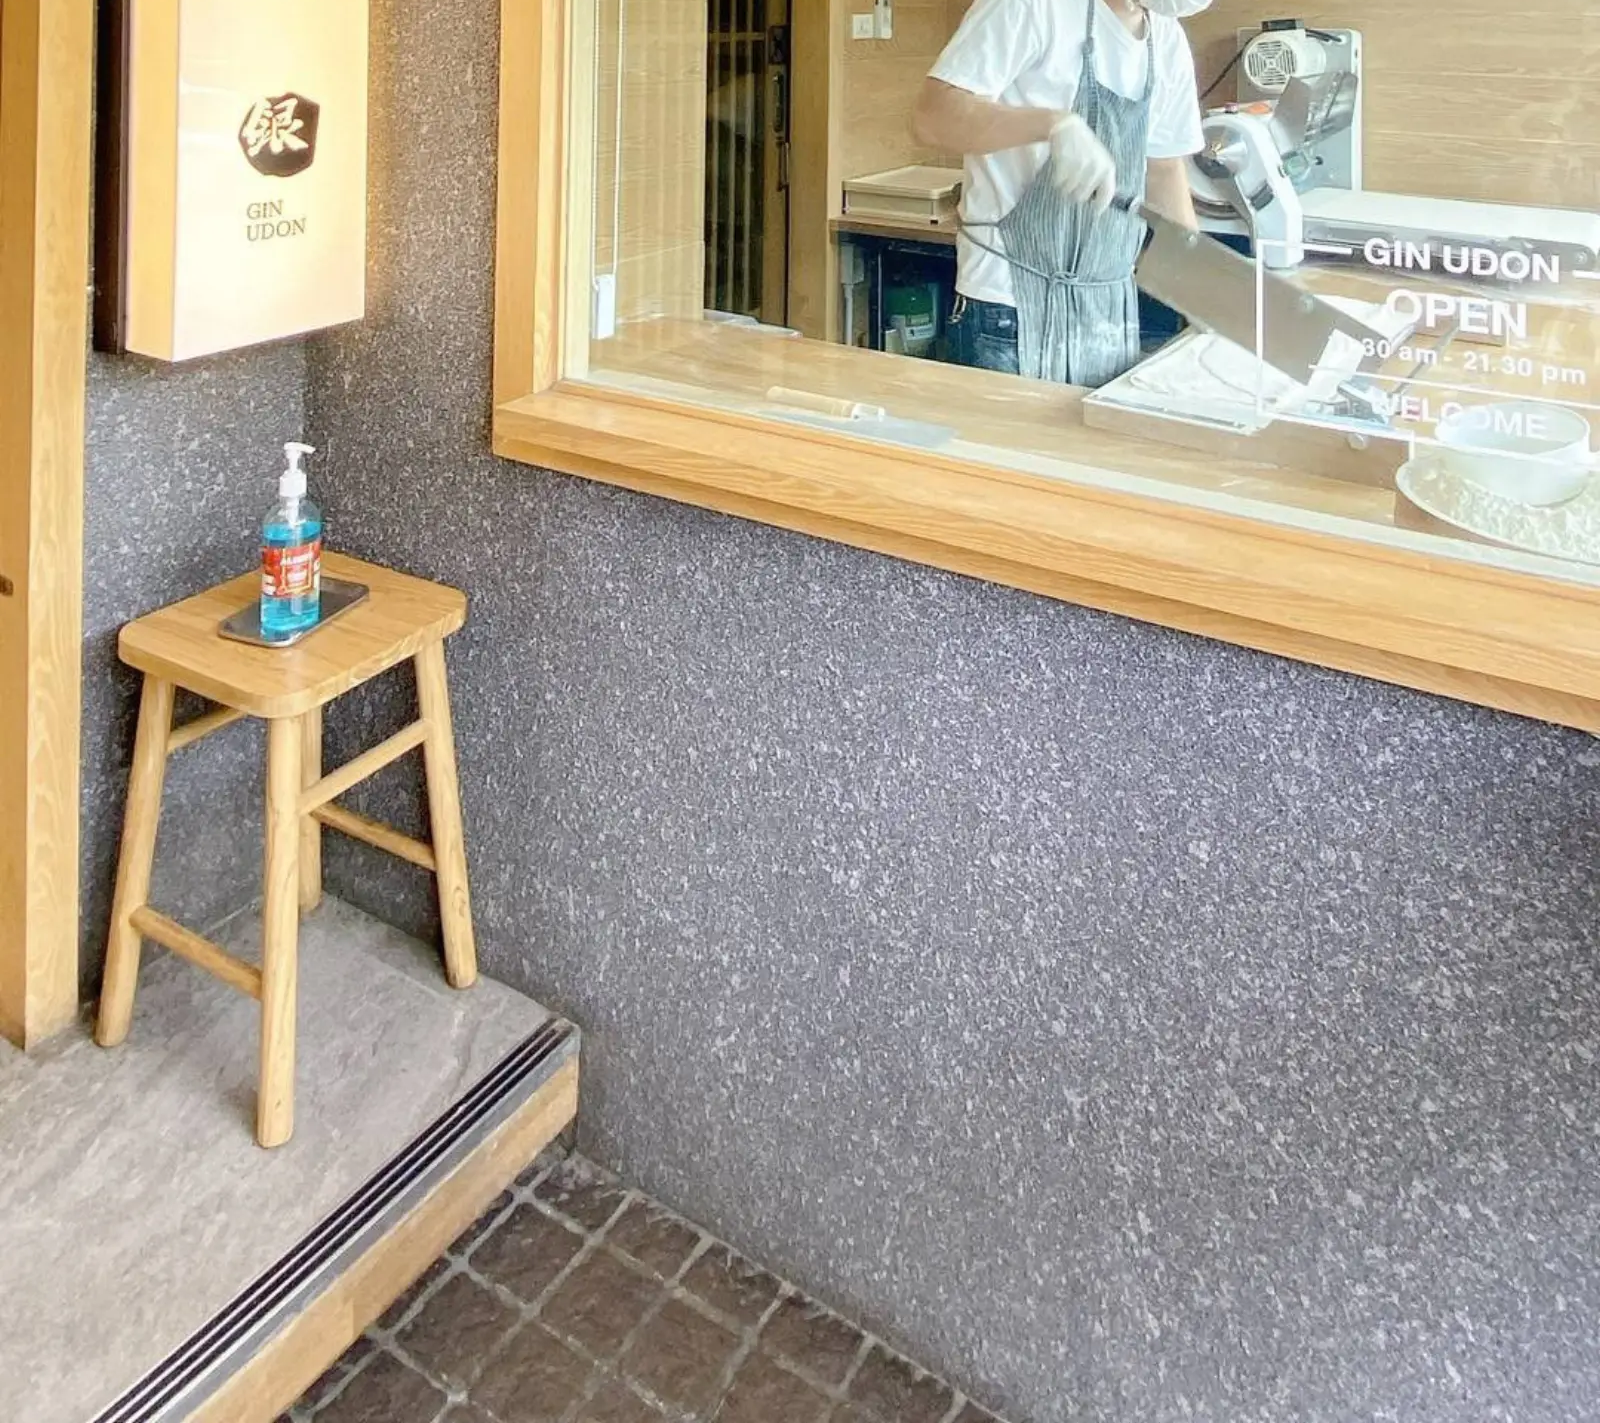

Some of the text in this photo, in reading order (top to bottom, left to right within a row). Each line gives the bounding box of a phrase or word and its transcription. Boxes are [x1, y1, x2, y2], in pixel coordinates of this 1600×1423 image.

[246, 199, 284, 220] GIN
[246, 217, 307, 242] UDON
[1364, 236, 1560, 283] GIN UDON
[1386, 289, 1527, 338] OPEN
[1398, 346, 1437, 365] am
[1542, 365, 1586, 385] pm
